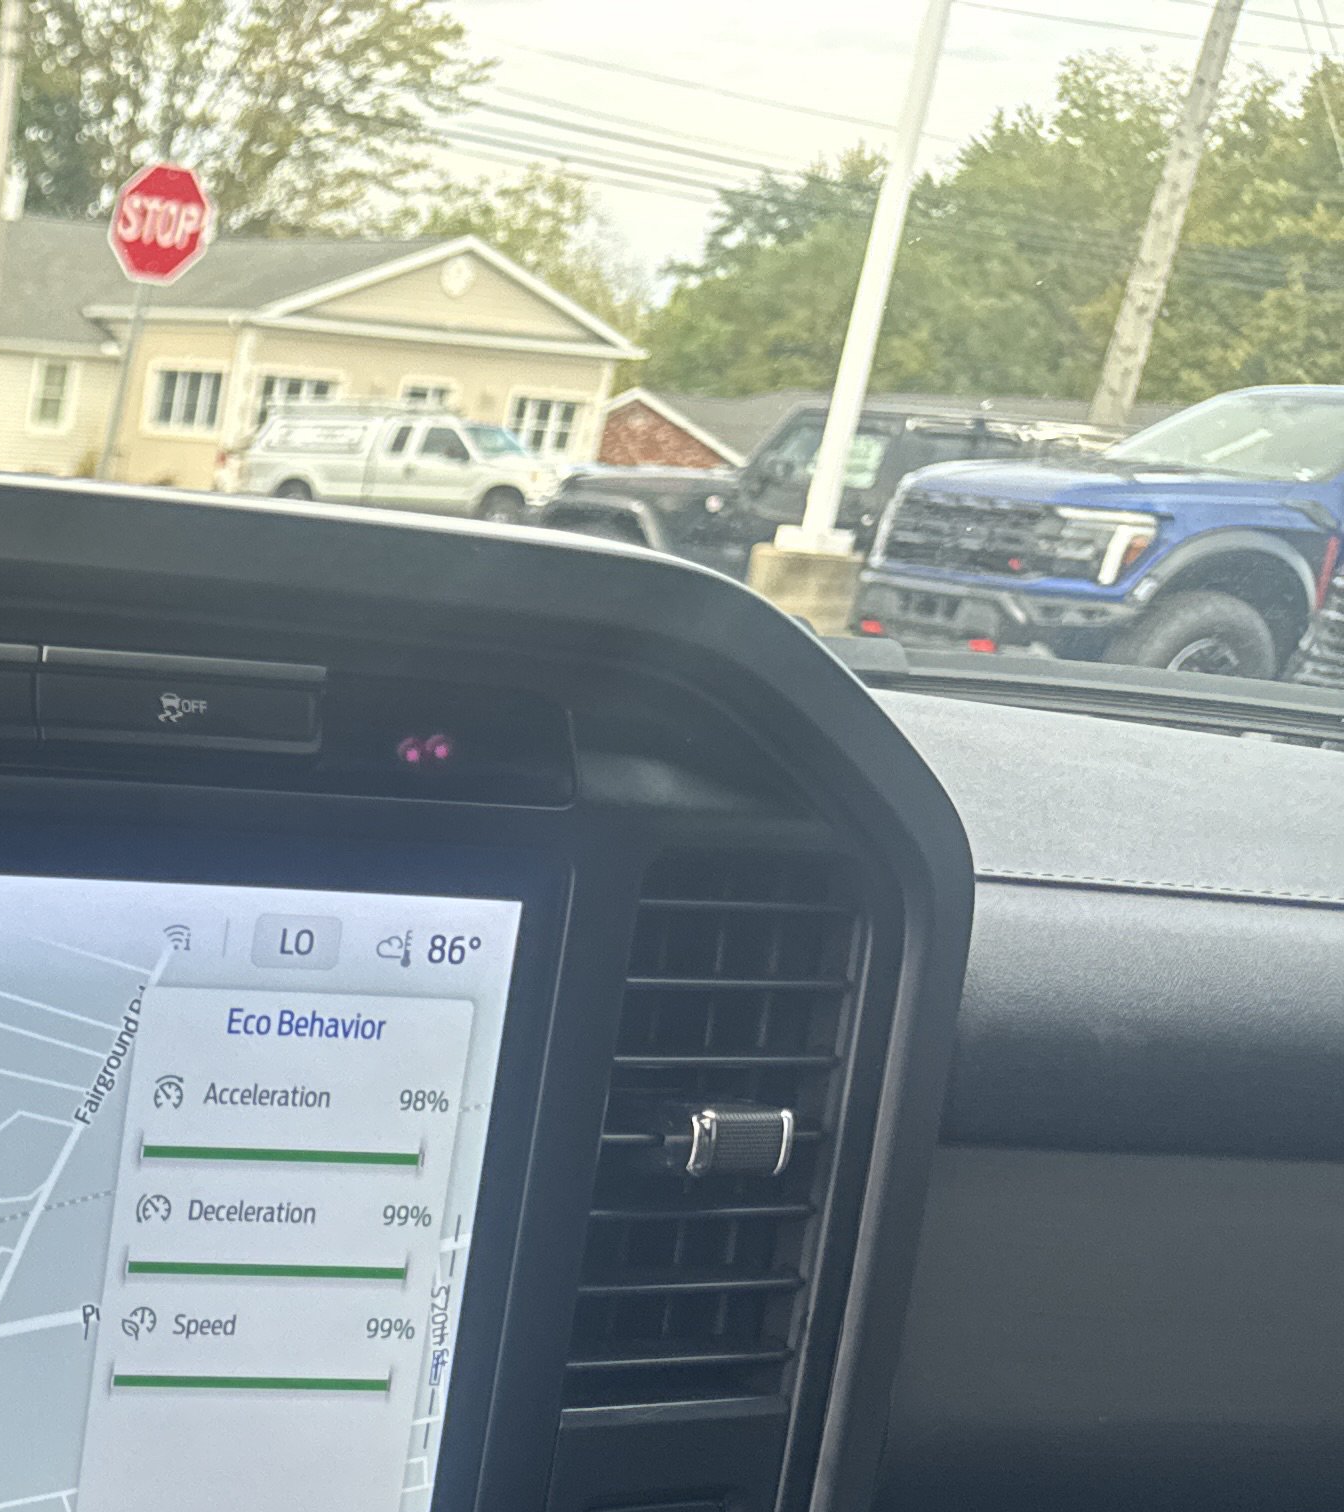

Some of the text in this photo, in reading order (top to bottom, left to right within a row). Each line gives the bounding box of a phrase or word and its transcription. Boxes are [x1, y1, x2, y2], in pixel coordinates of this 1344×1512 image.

[117, 194, 204, 250] STOP
[181, 698, 208, 716] OFF
[278, 927, 315, 957] LO
[427, 934, 482, 966] 86°
[226, 1008, 387, 1041] Eco Behavior
[74, 1015, 139, 1126] Fairground
[203, 1082, 450, 1113] Acceleration 98%
[187, 1199, 433, 1228] Deceleration 99%
[172, 1313, 416, 1341] Speed 99%
